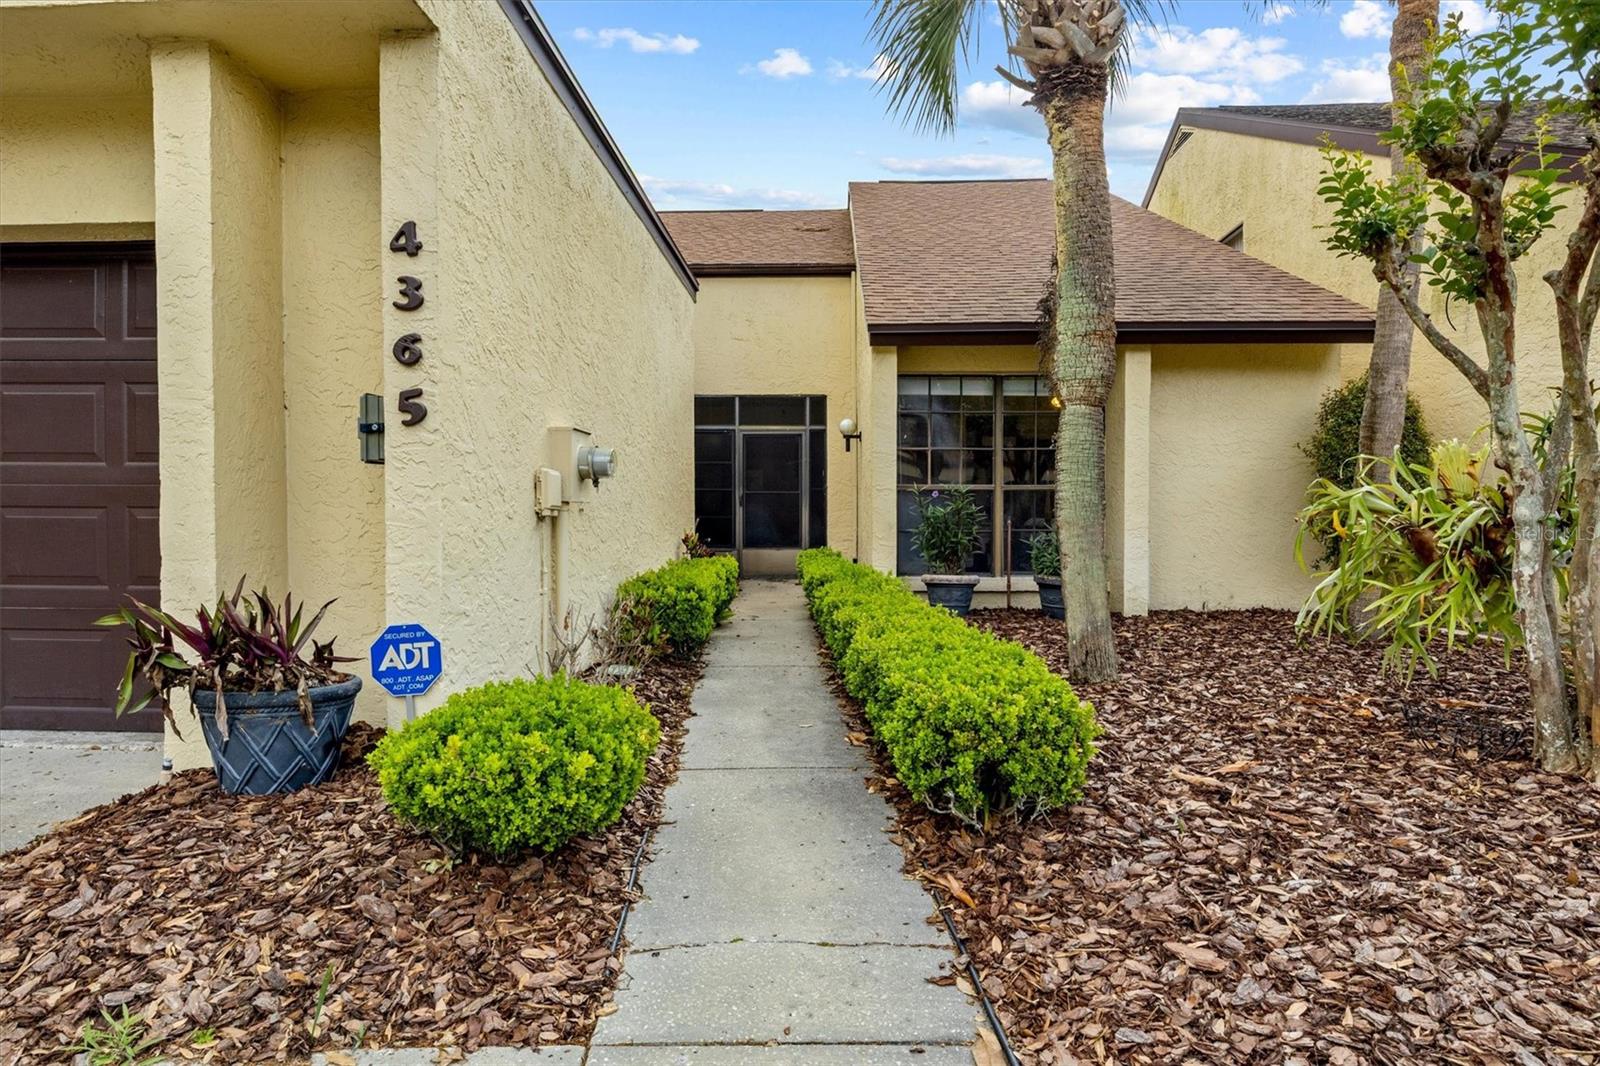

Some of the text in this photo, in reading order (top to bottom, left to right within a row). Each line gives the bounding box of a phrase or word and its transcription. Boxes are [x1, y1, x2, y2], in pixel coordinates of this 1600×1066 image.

[389, 220, 428, 427] 4365
[383, 632, 415, 640] SECURED
[378, 641, 435, 672] ADT
